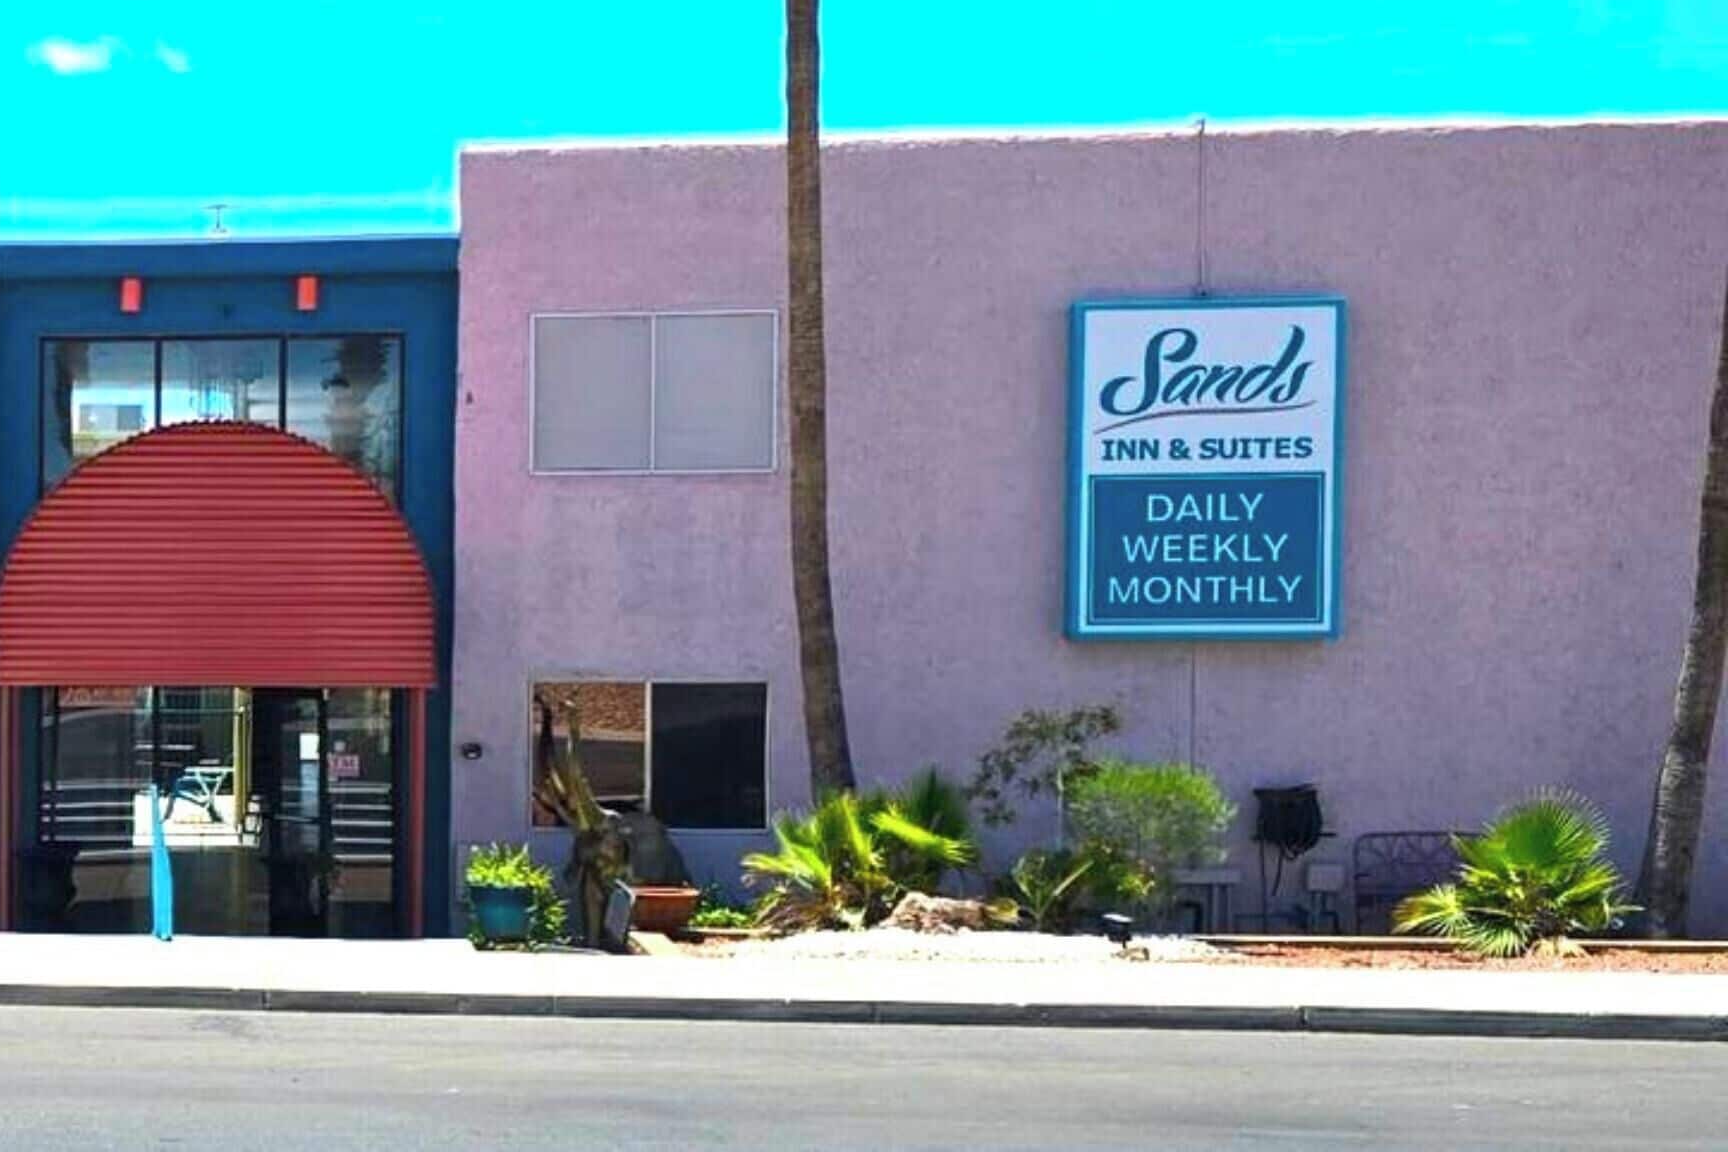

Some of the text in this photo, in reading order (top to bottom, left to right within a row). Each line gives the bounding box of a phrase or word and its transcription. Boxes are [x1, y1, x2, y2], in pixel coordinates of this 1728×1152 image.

[1099, 324, 1314, 416] Sands
[1101, 436, 1314, 461] INN & SUITES
[1147, 493, 1264, 522] DAILY
[1123, 534, 1289, 562] WEEKLY
[1108, 575, 1303, 603] MONTHLY
